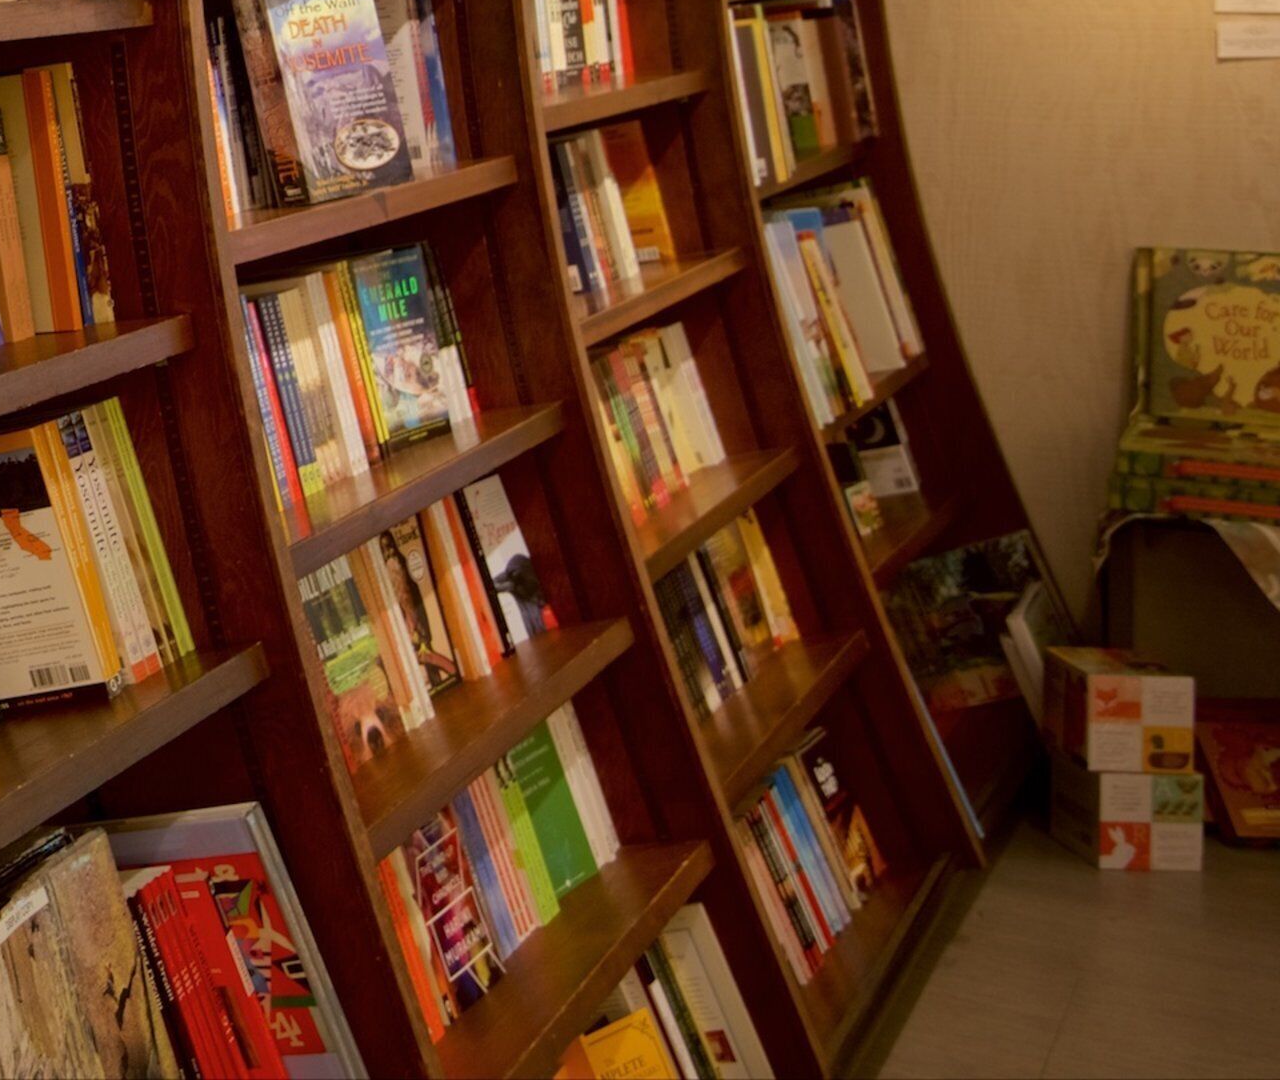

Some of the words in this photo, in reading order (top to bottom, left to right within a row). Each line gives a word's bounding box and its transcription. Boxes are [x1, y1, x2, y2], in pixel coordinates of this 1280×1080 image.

[299, 0, 321, 14] the
[288, 14, 349, 40] DEATH
[1204, 301, 1249, 320] Care
[1225, 319, 1260, 338] Our
[1212, 335, 1270, 361] World
